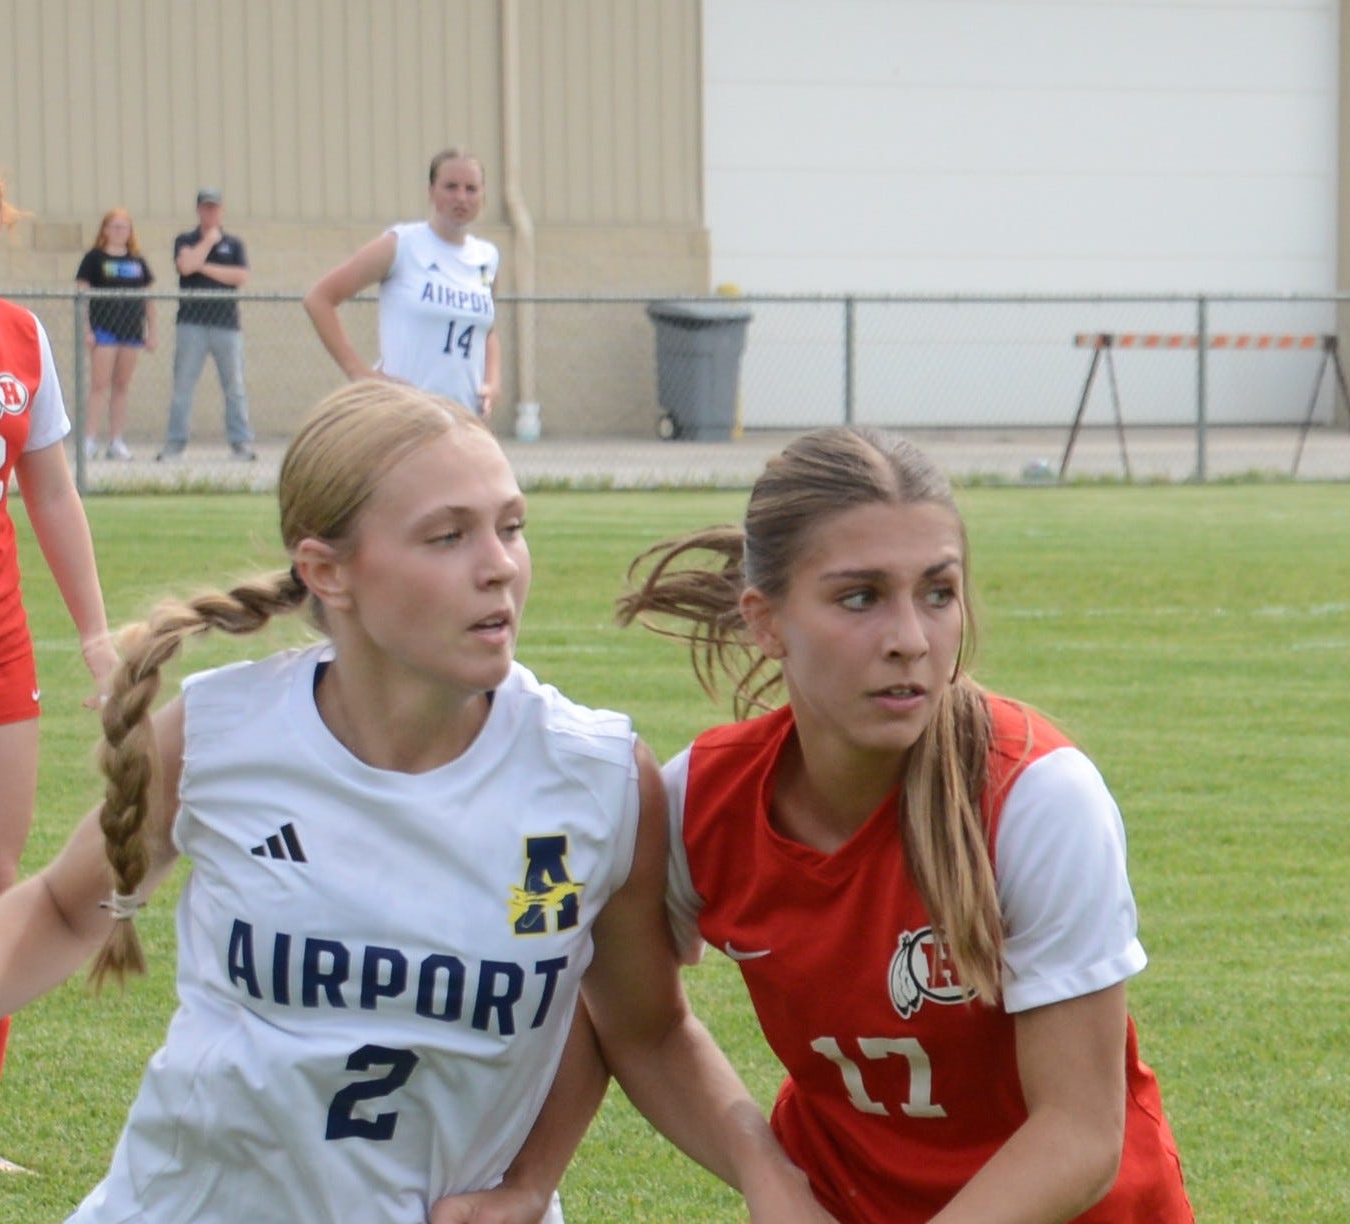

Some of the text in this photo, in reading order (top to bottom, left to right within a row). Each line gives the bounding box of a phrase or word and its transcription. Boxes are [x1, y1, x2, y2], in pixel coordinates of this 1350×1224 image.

[421, 282, 490, 314] AIRPOR
[443, 320, 475, 358] 14
[227, 918, 569, 1036] AIRPORT
[324, 1044, 420, 1141] 2
[810, 1036, 948, 1118] 17
